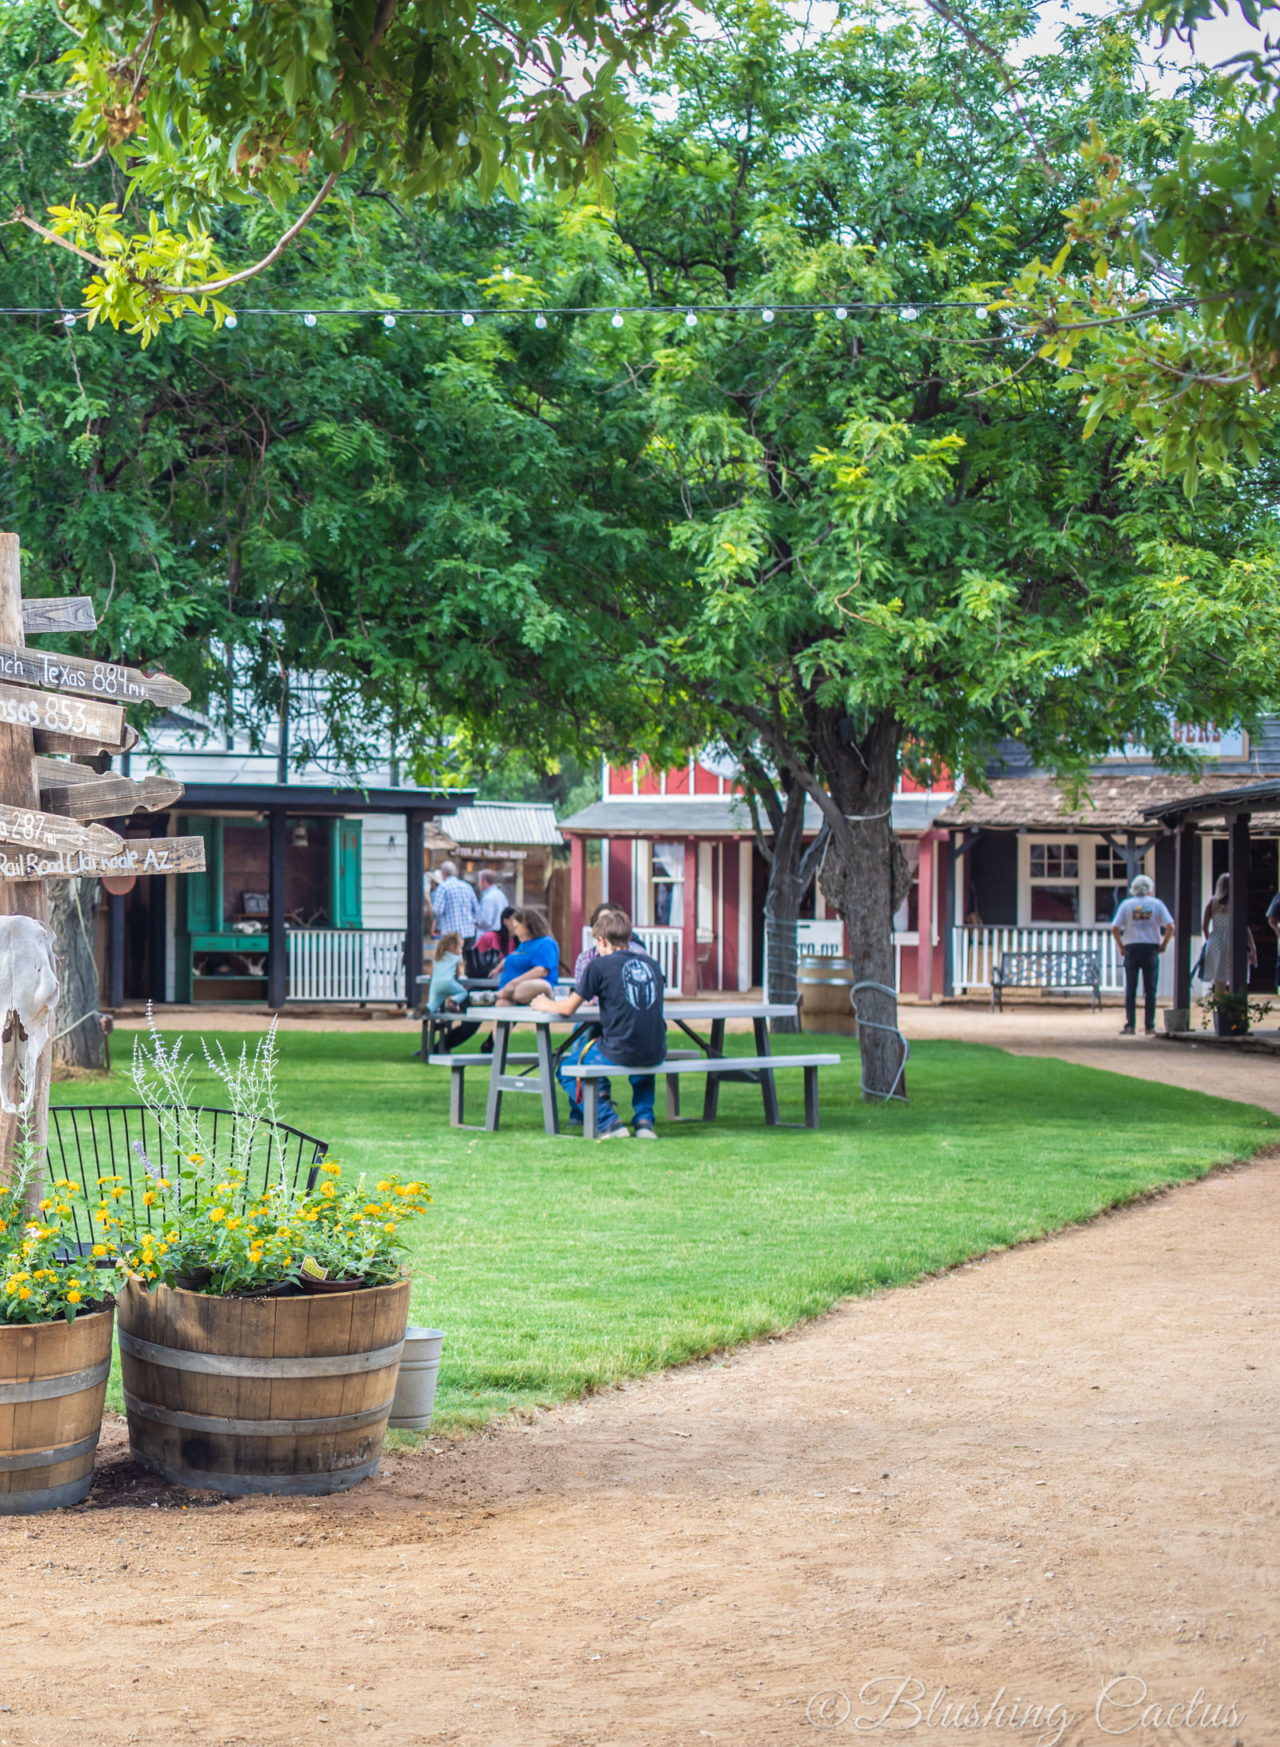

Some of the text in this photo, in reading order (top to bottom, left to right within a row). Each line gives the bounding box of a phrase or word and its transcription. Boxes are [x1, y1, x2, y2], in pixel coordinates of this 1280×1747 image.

[92, 664, 127, 694] 884
[44, 697, 87, 734] 853
[11, 811, 46, 841] 287
[142, 847, 174, 872] AZ
